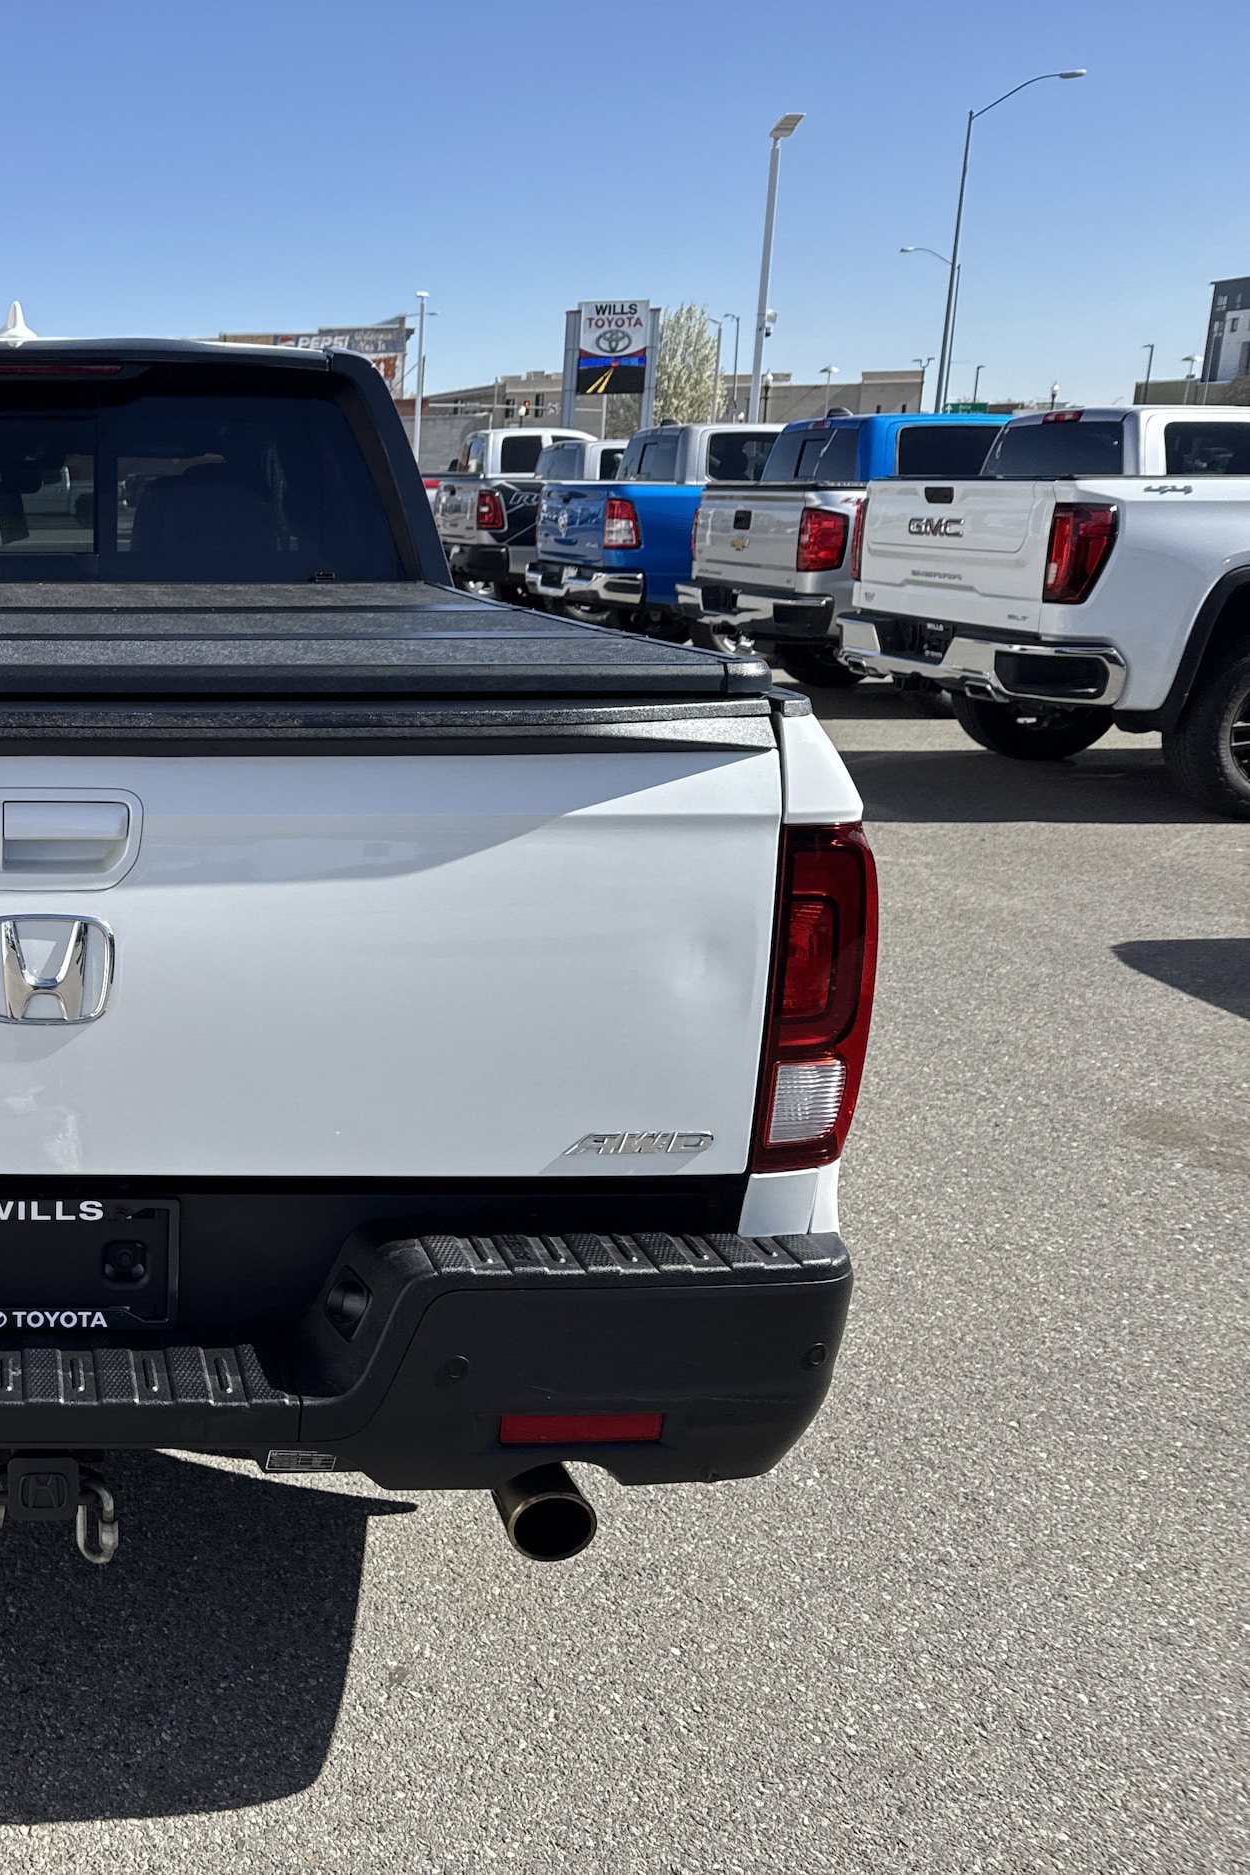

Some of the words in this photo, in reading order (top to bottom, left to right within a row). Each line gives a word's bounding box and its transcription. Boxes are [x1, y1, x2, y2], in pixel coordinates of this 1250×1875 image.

[595, 303, 638, 316] WILLS
[586, 316, 643, 329] TOYOTA
[297, 334, 350, 349] PEPSI
[909, 517, 964, 537] GMC
[565, 1131, 714, 1155] AWD
[12, 1311, 108, 1328] TOYOTA
